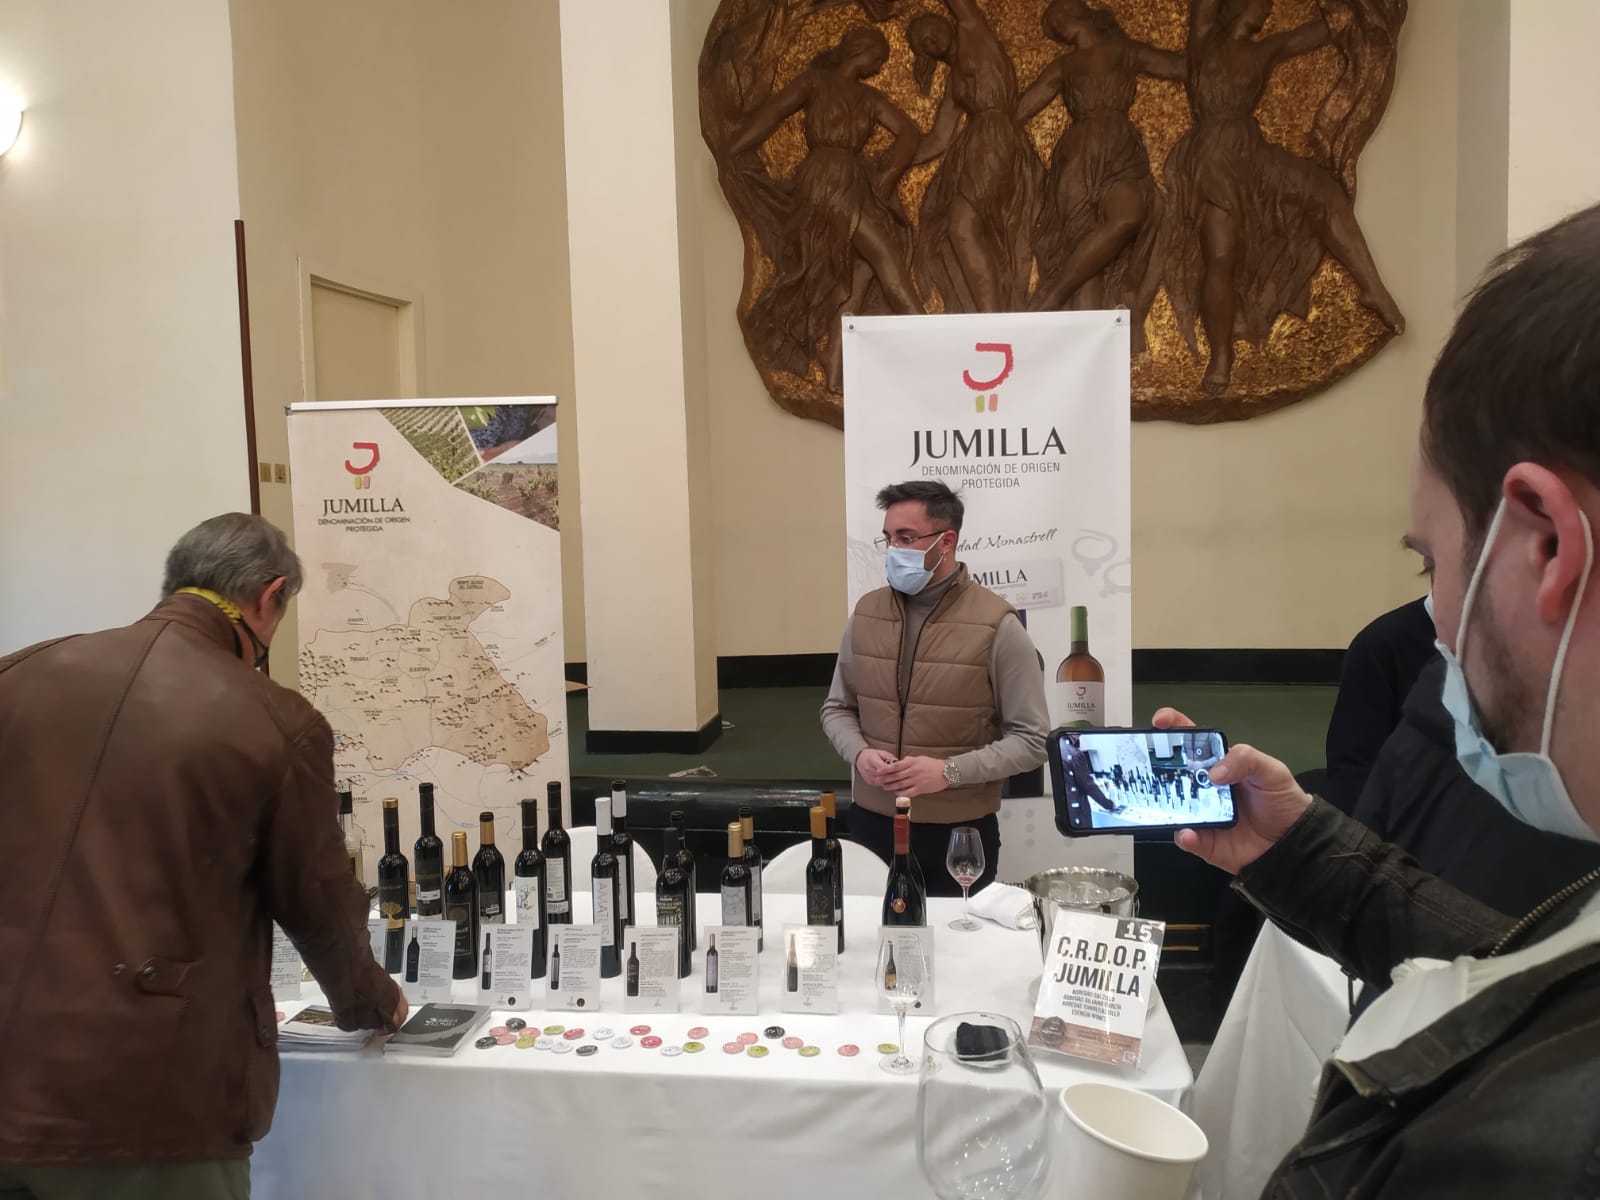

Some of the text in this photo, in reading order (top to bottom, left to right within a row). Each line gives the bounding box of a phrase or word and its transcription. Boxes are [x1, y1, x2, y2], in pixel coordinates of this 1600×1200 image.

[909, 426, 1067, 468] JUMILLA
[921, 461, 1060, 477] DENOMINACIÓN DE ORIGEN
[961, 477, 1020, 489] PROTEGIDA
[322, 498, 404, 516] JUMILLA
[983, 528, 1058, 550] Monastrell
[968, 569, 1028, 586] MILLA
[1124, 921, 1153, 941] 15
[1056, 936, 1147, 970] C.R.D.O.P.
[1055, 963, 1140, 998] JUMILLA
